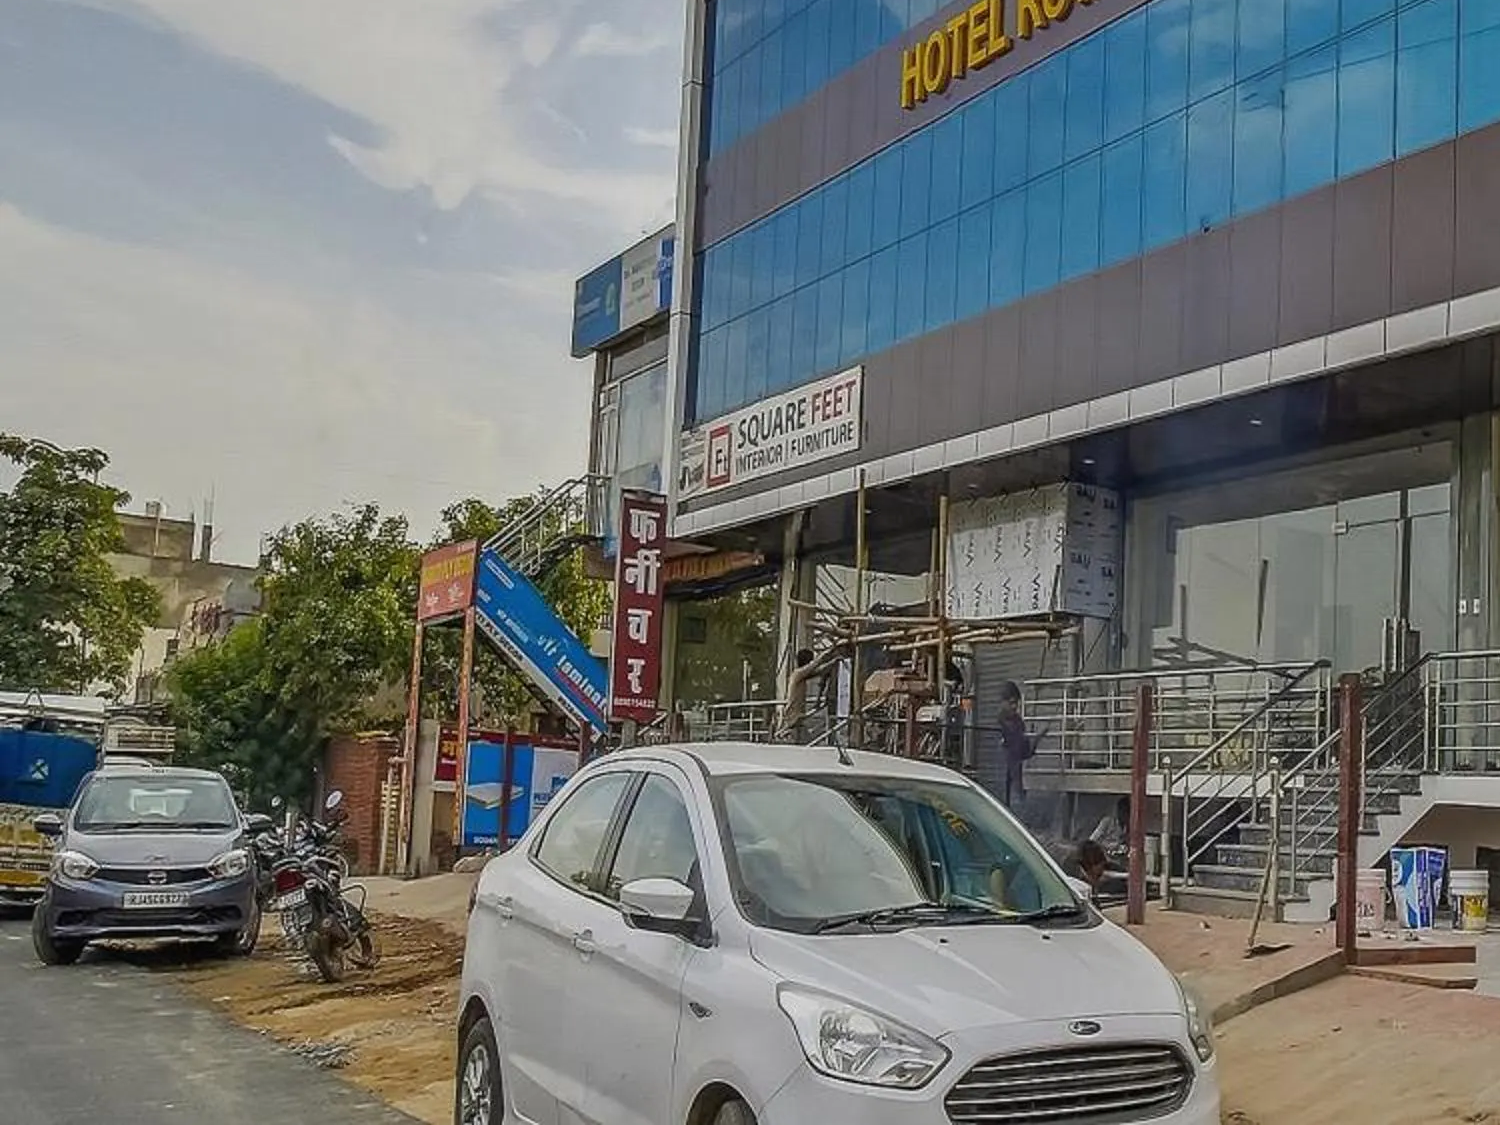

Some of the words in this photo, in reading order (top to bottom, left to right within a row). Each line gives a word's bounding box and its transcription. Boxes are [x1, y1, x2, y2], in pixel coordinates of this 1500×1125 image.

[737, 397, 807, 449] SQUARE
[811, 380, 858, 425] FEET
[736, 443, 783, 476] INTERIOR
[791, 420, 854, 456] FURNITURE
